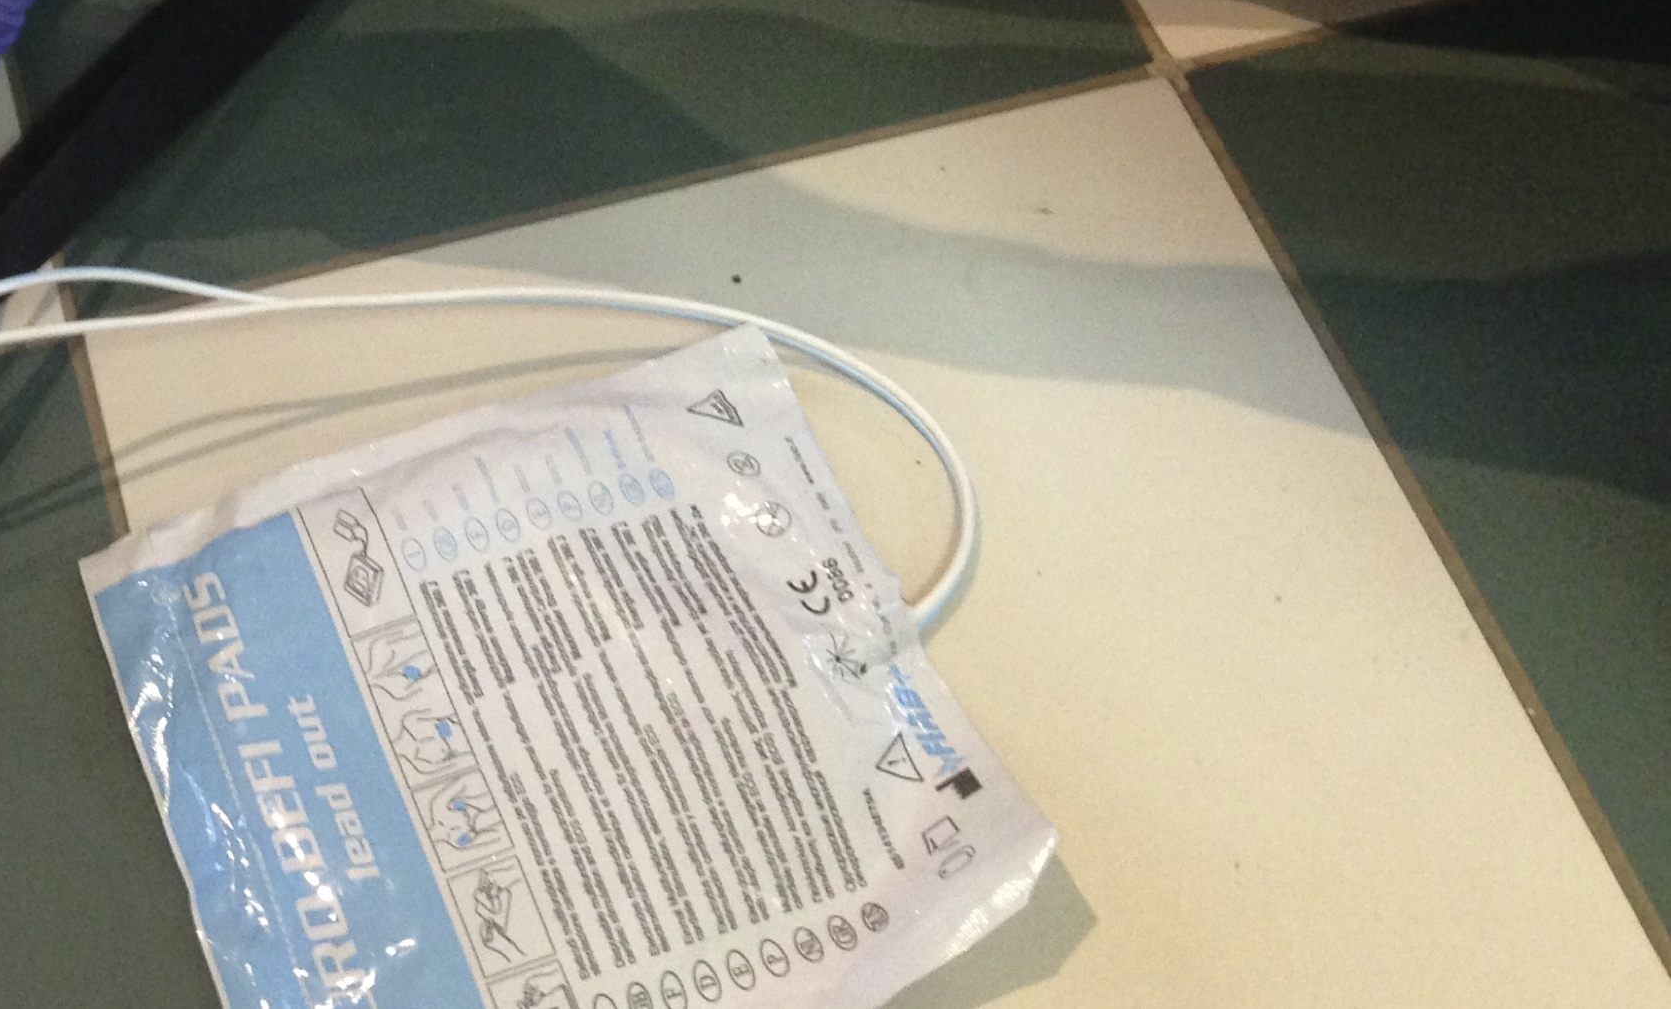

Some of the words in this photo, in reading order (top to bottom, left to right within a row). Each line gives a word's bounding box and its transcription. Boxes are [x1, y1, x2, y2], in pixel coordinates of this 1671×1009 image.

[822, 556, 855, 604] 0086
[186, 572, 269, 723] PADS
[287, 693, 338, 771] out
[315, 783, 381, 881] lead
